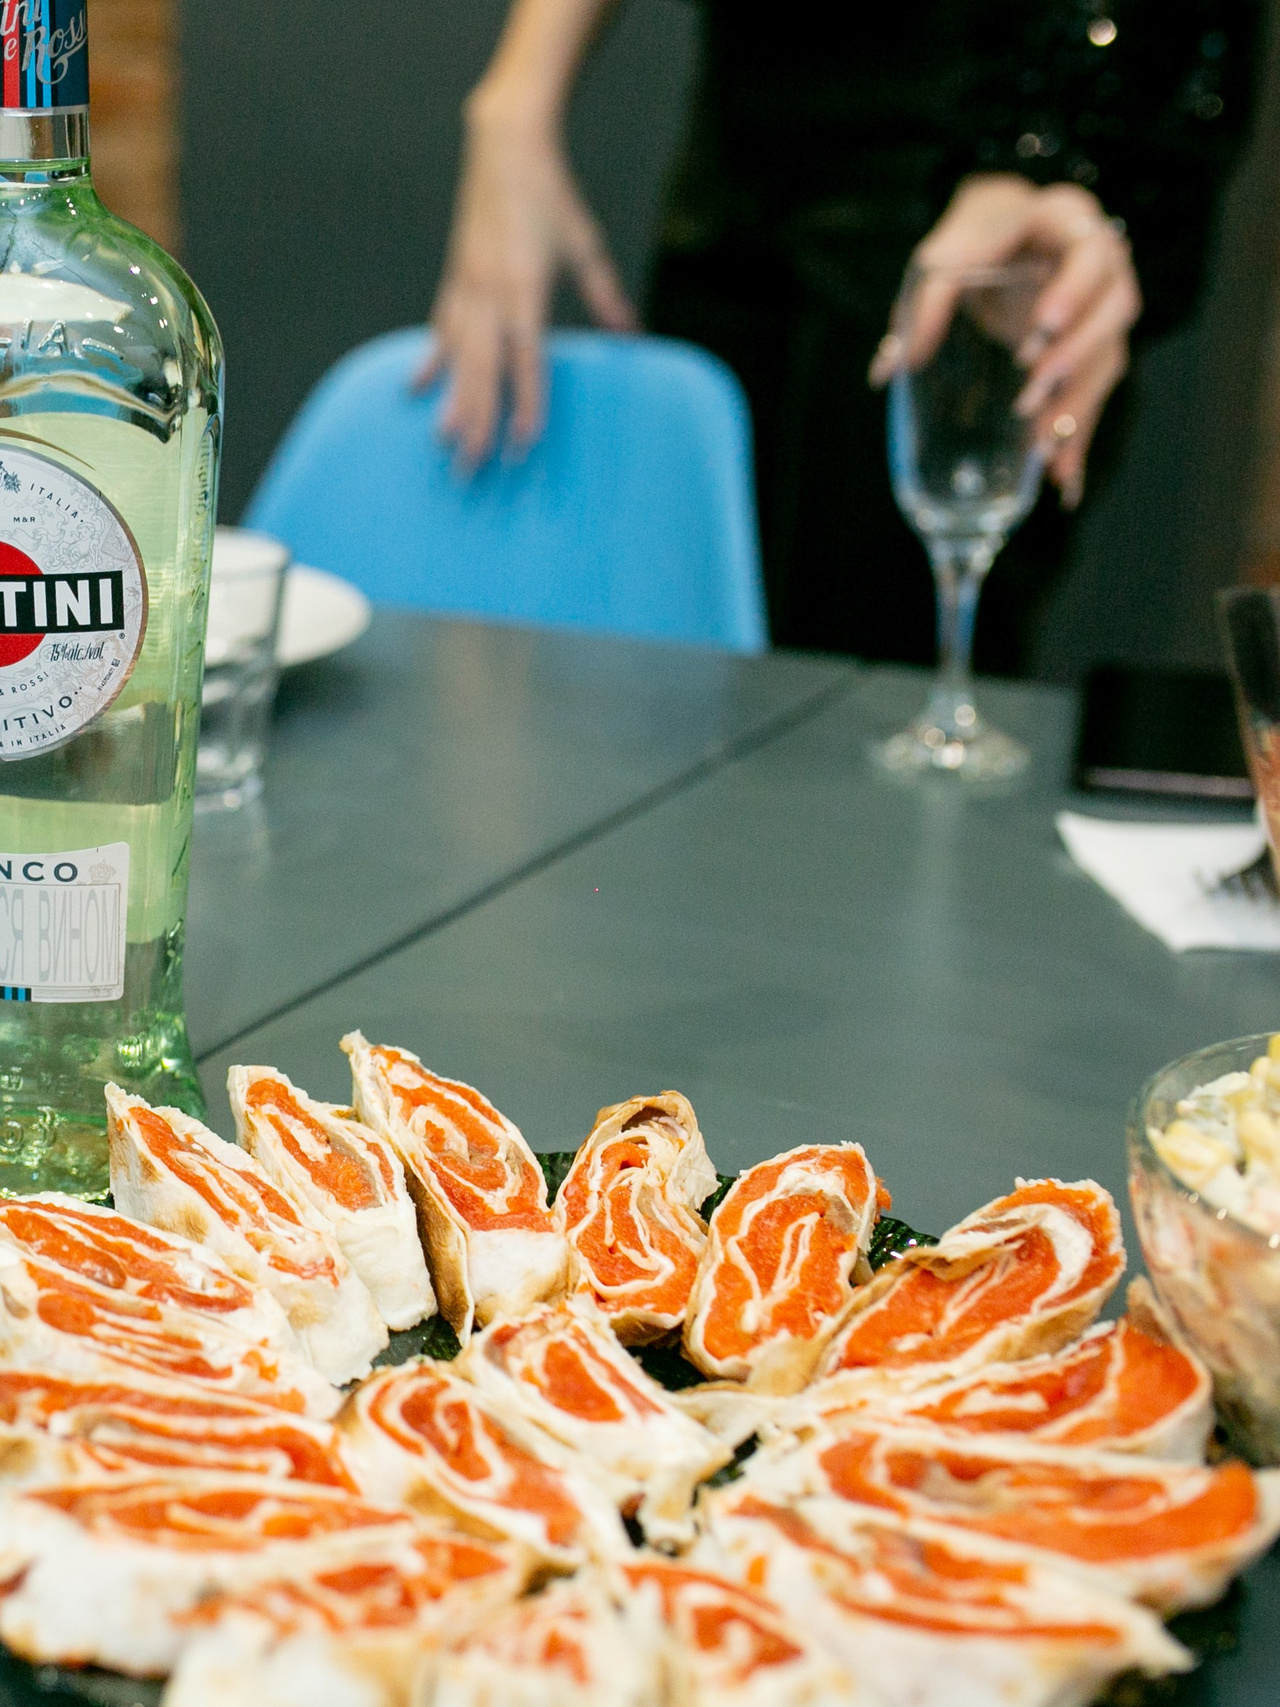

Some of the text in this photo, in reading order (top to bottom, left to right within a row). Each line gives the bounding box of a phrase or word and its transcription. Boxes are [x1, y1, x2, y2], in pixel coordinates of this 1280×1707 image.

[4, 38, 18, 60] e
[30, 482, 78, 519] ITALIA
[11, 671, 49, 694] ROSSI
[11, 739, 23, 747] IN
[29, 724, 67, 744] ITALIA
[38, 888, 118, 983] ВИНОМ
